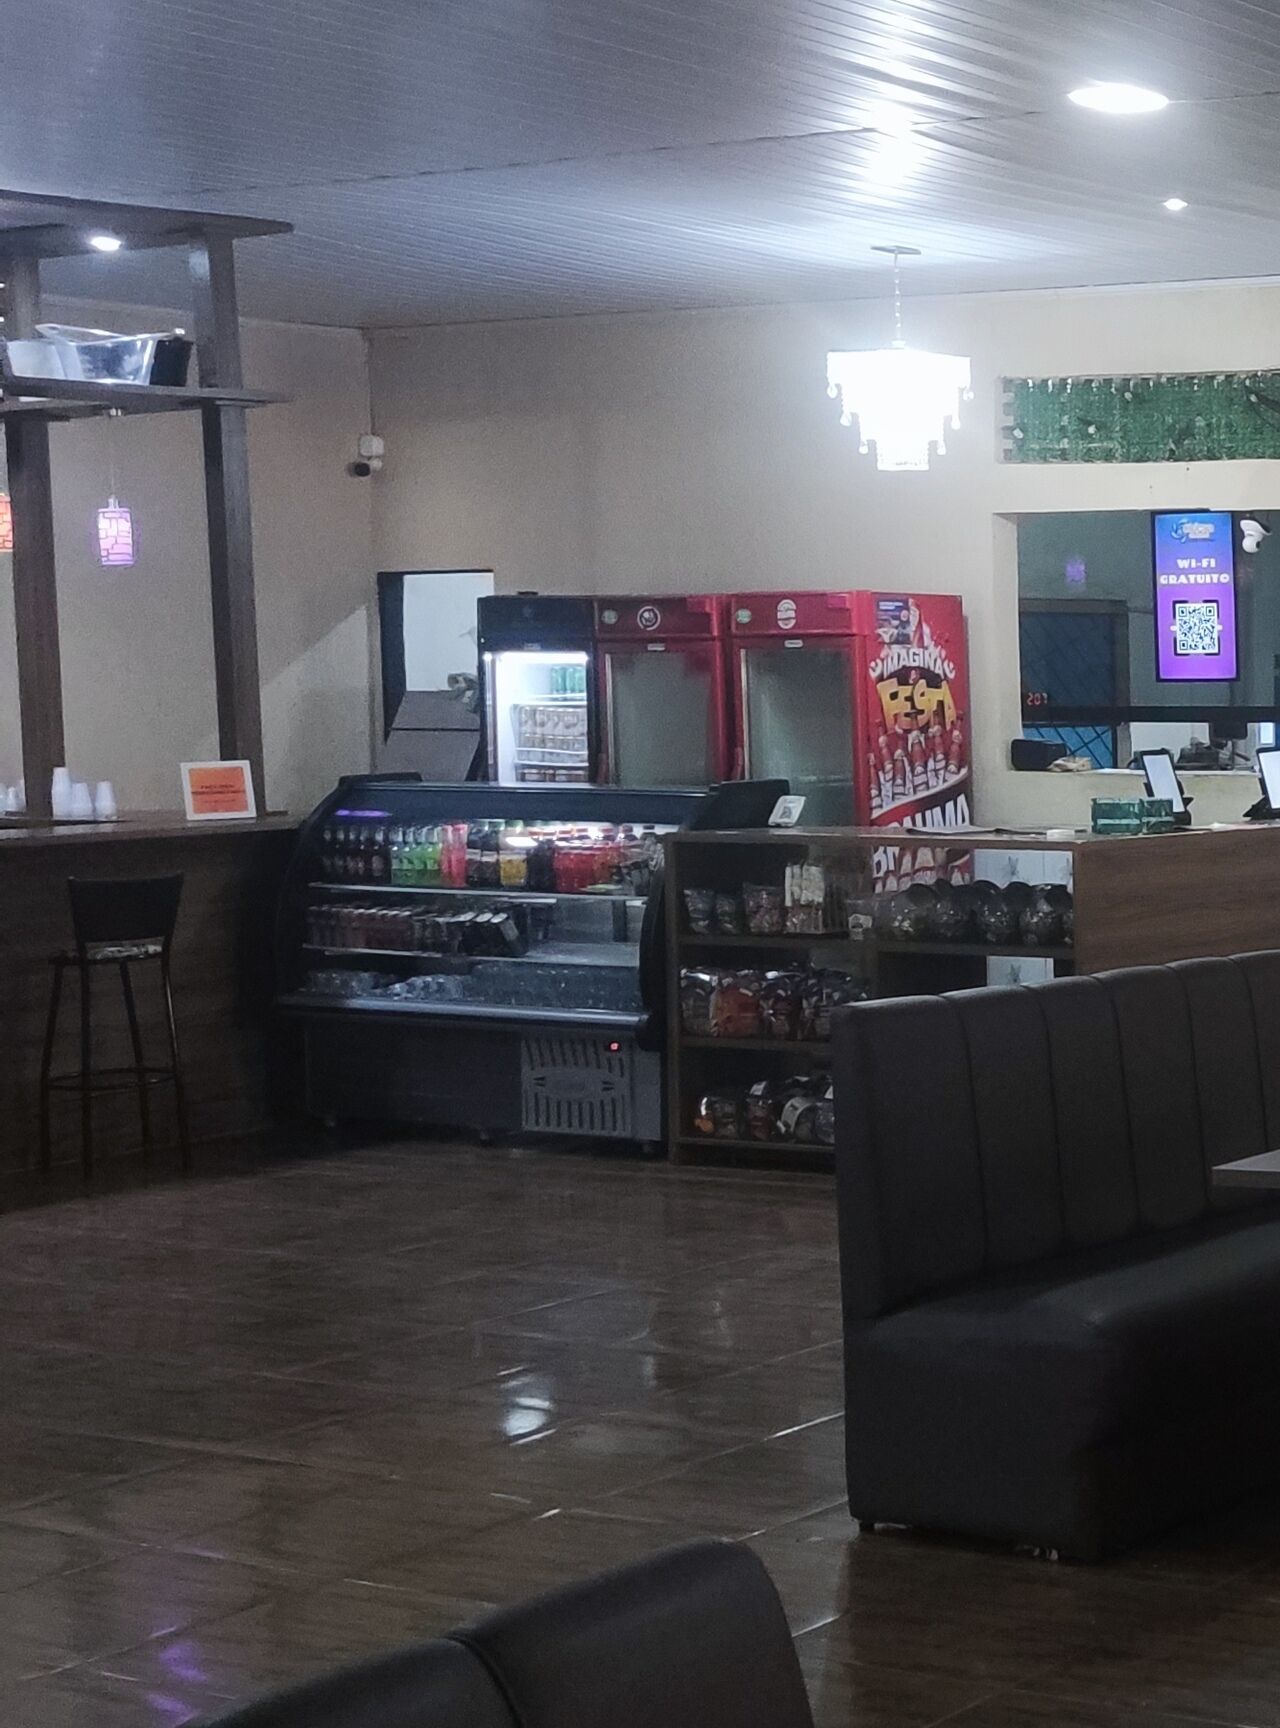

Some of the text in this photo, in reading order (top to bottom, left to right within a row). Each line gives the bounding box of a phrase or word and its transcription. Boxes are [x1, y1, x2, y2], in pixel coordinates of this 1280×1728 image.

[1177, 558, 1217, 568] WI-FI
[1160, 573, 1230, 584] GRATUITO
[883, 644, 945, 680] IMAGINA
[876, 677, 957, 733] FESTA
